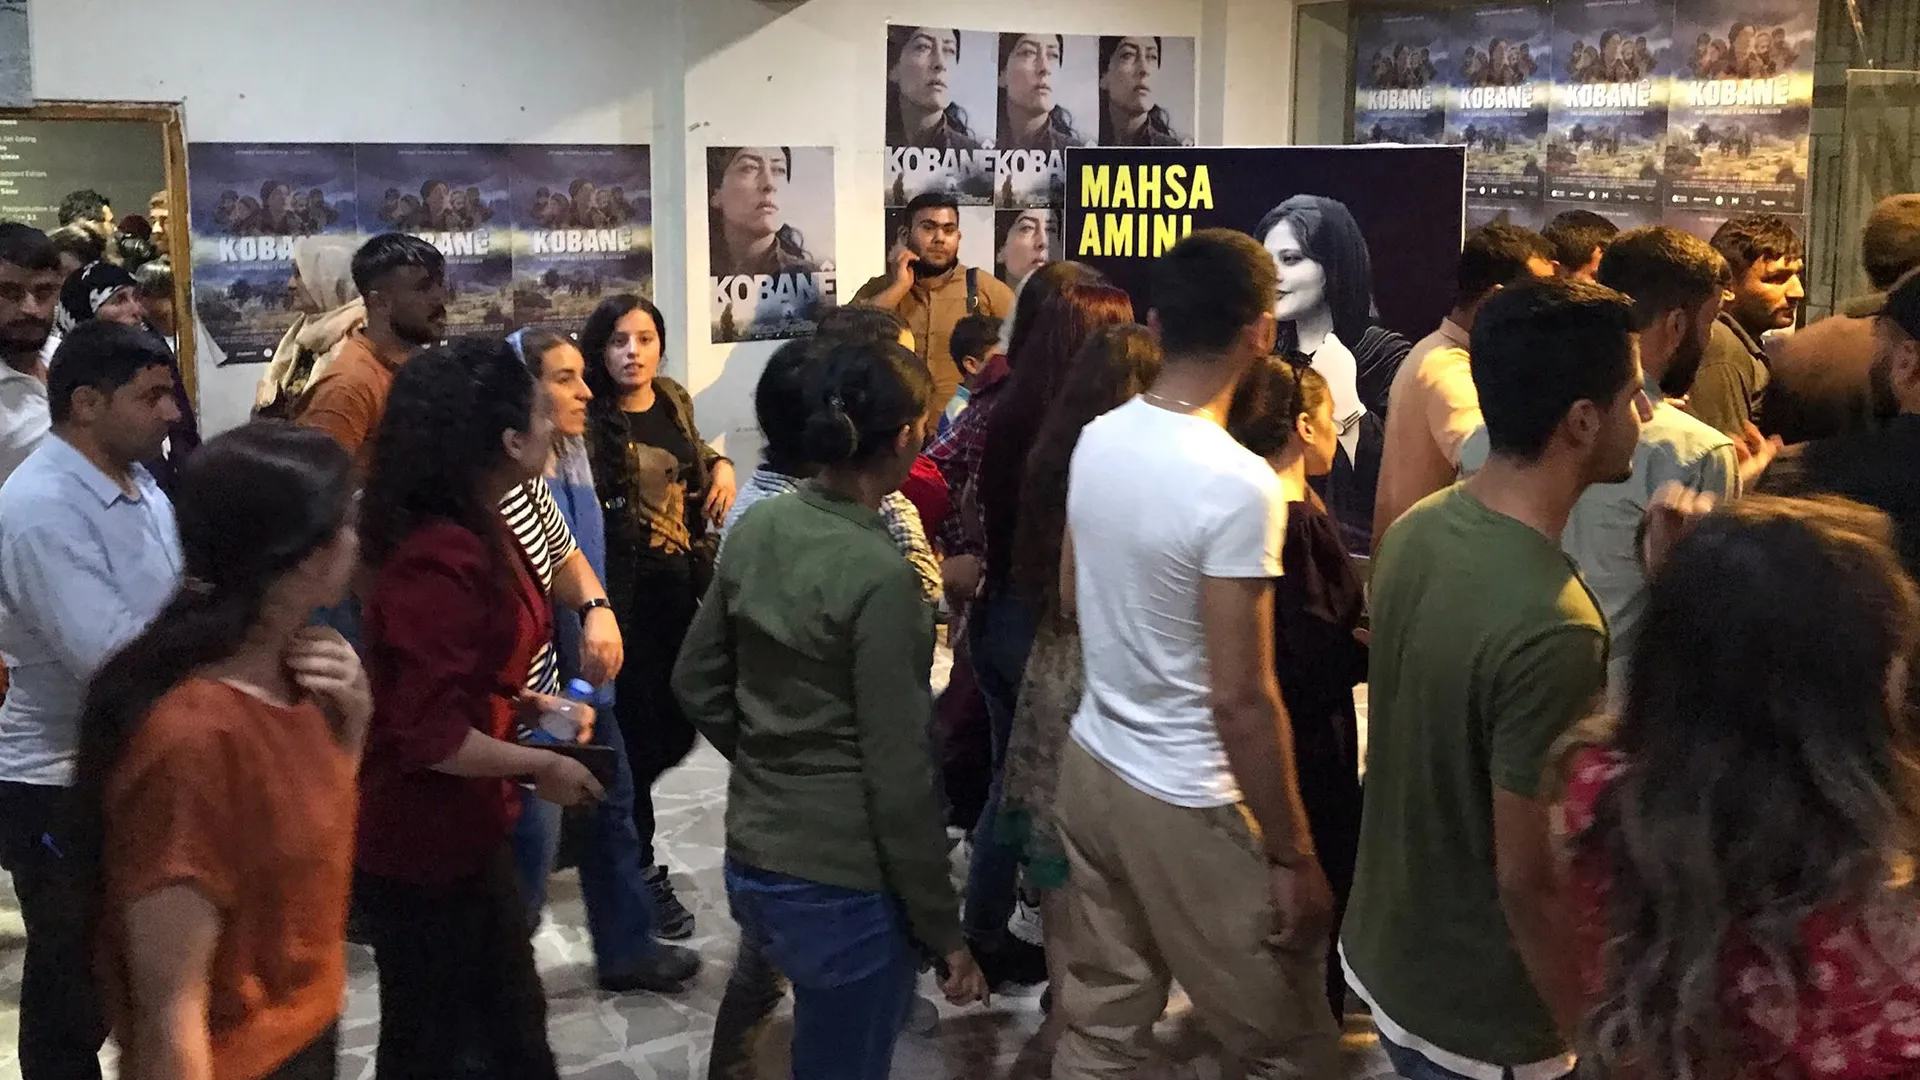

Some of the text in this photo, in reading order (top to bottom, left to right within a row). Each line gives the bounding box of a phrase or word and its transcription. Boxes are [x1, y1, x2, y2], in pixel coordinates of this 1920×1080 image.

[1367, 86, 1432, 110] KOBANÊ
[1459, 82, 1533, 109] KOBANÊ
[1564, 78, 1651, 107] KOBANÊ
[1688, 74, 1789, 106] KOBANÊ
[884, 139, 995, 175] KOBANÊ
[996, 148, 1064, 175] KOBA
[1080, 164, 1214, 210] MAHSA
[219, 236, 295, 262] KOBA
[533, 226, 633, 253] KOBANÊ
[709, 259, 837, 308] KOBANÊ
